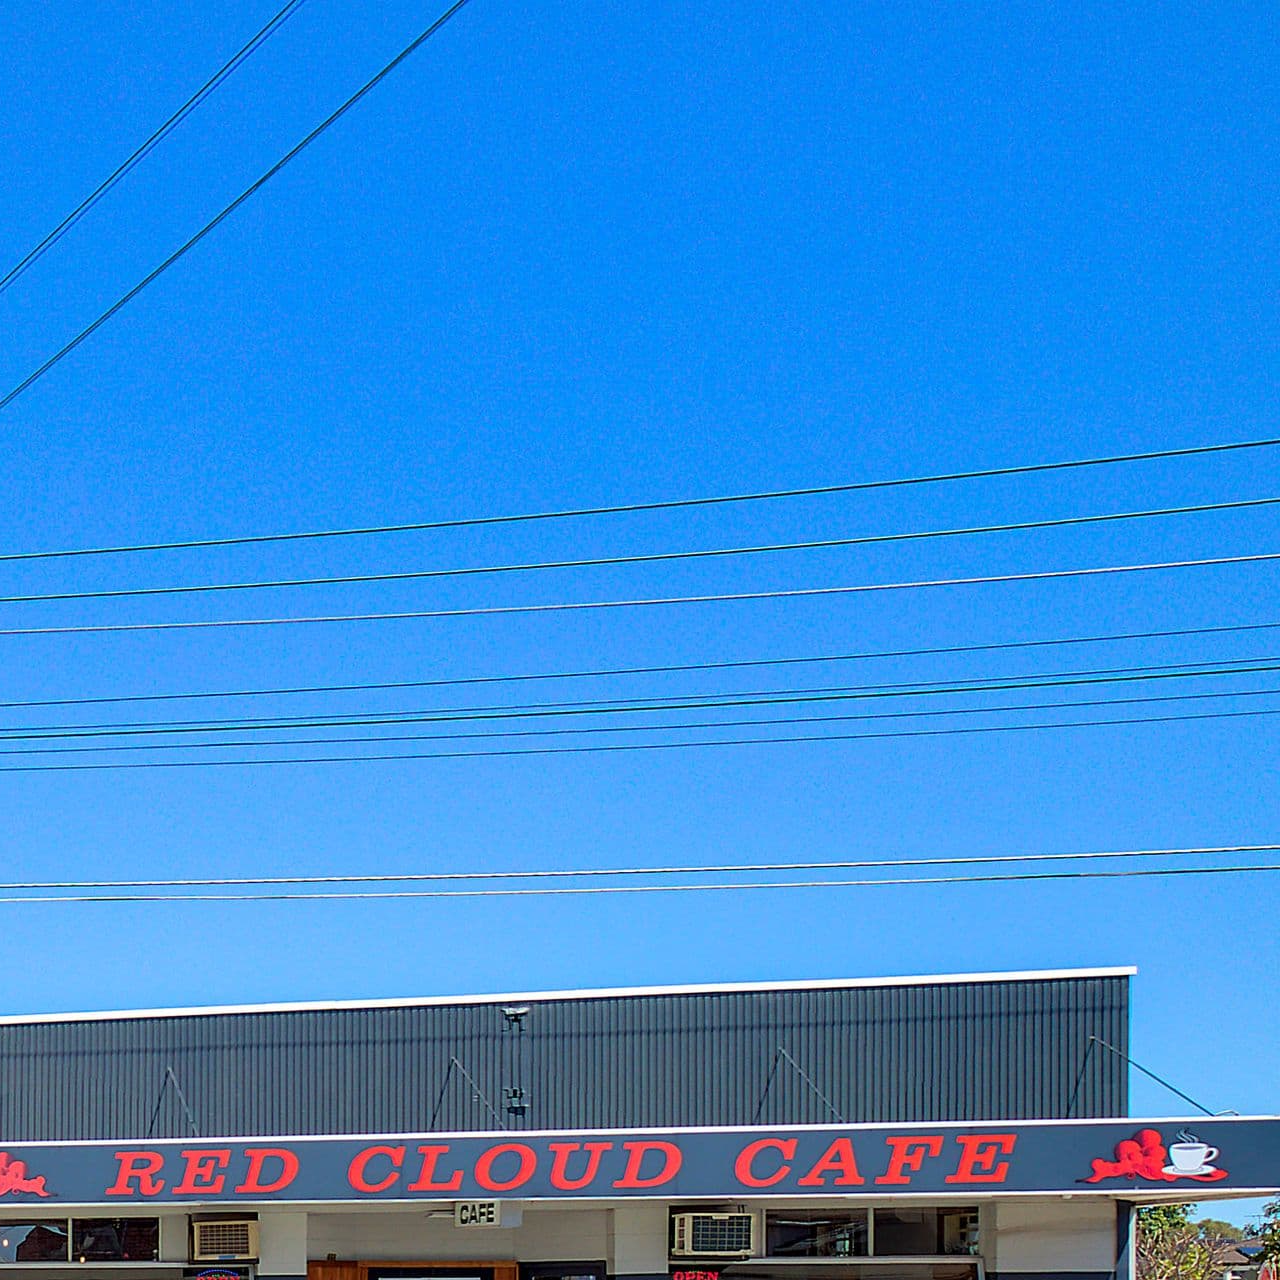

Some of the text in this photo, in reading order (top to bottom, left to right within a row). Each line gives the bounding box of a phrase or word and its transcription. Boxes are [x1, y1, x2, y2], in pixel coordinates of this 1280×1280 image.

[105, 1133, 1017, 1196] RED CLOUD CAFE
[459, 1203, 495, 1224] CAFE
